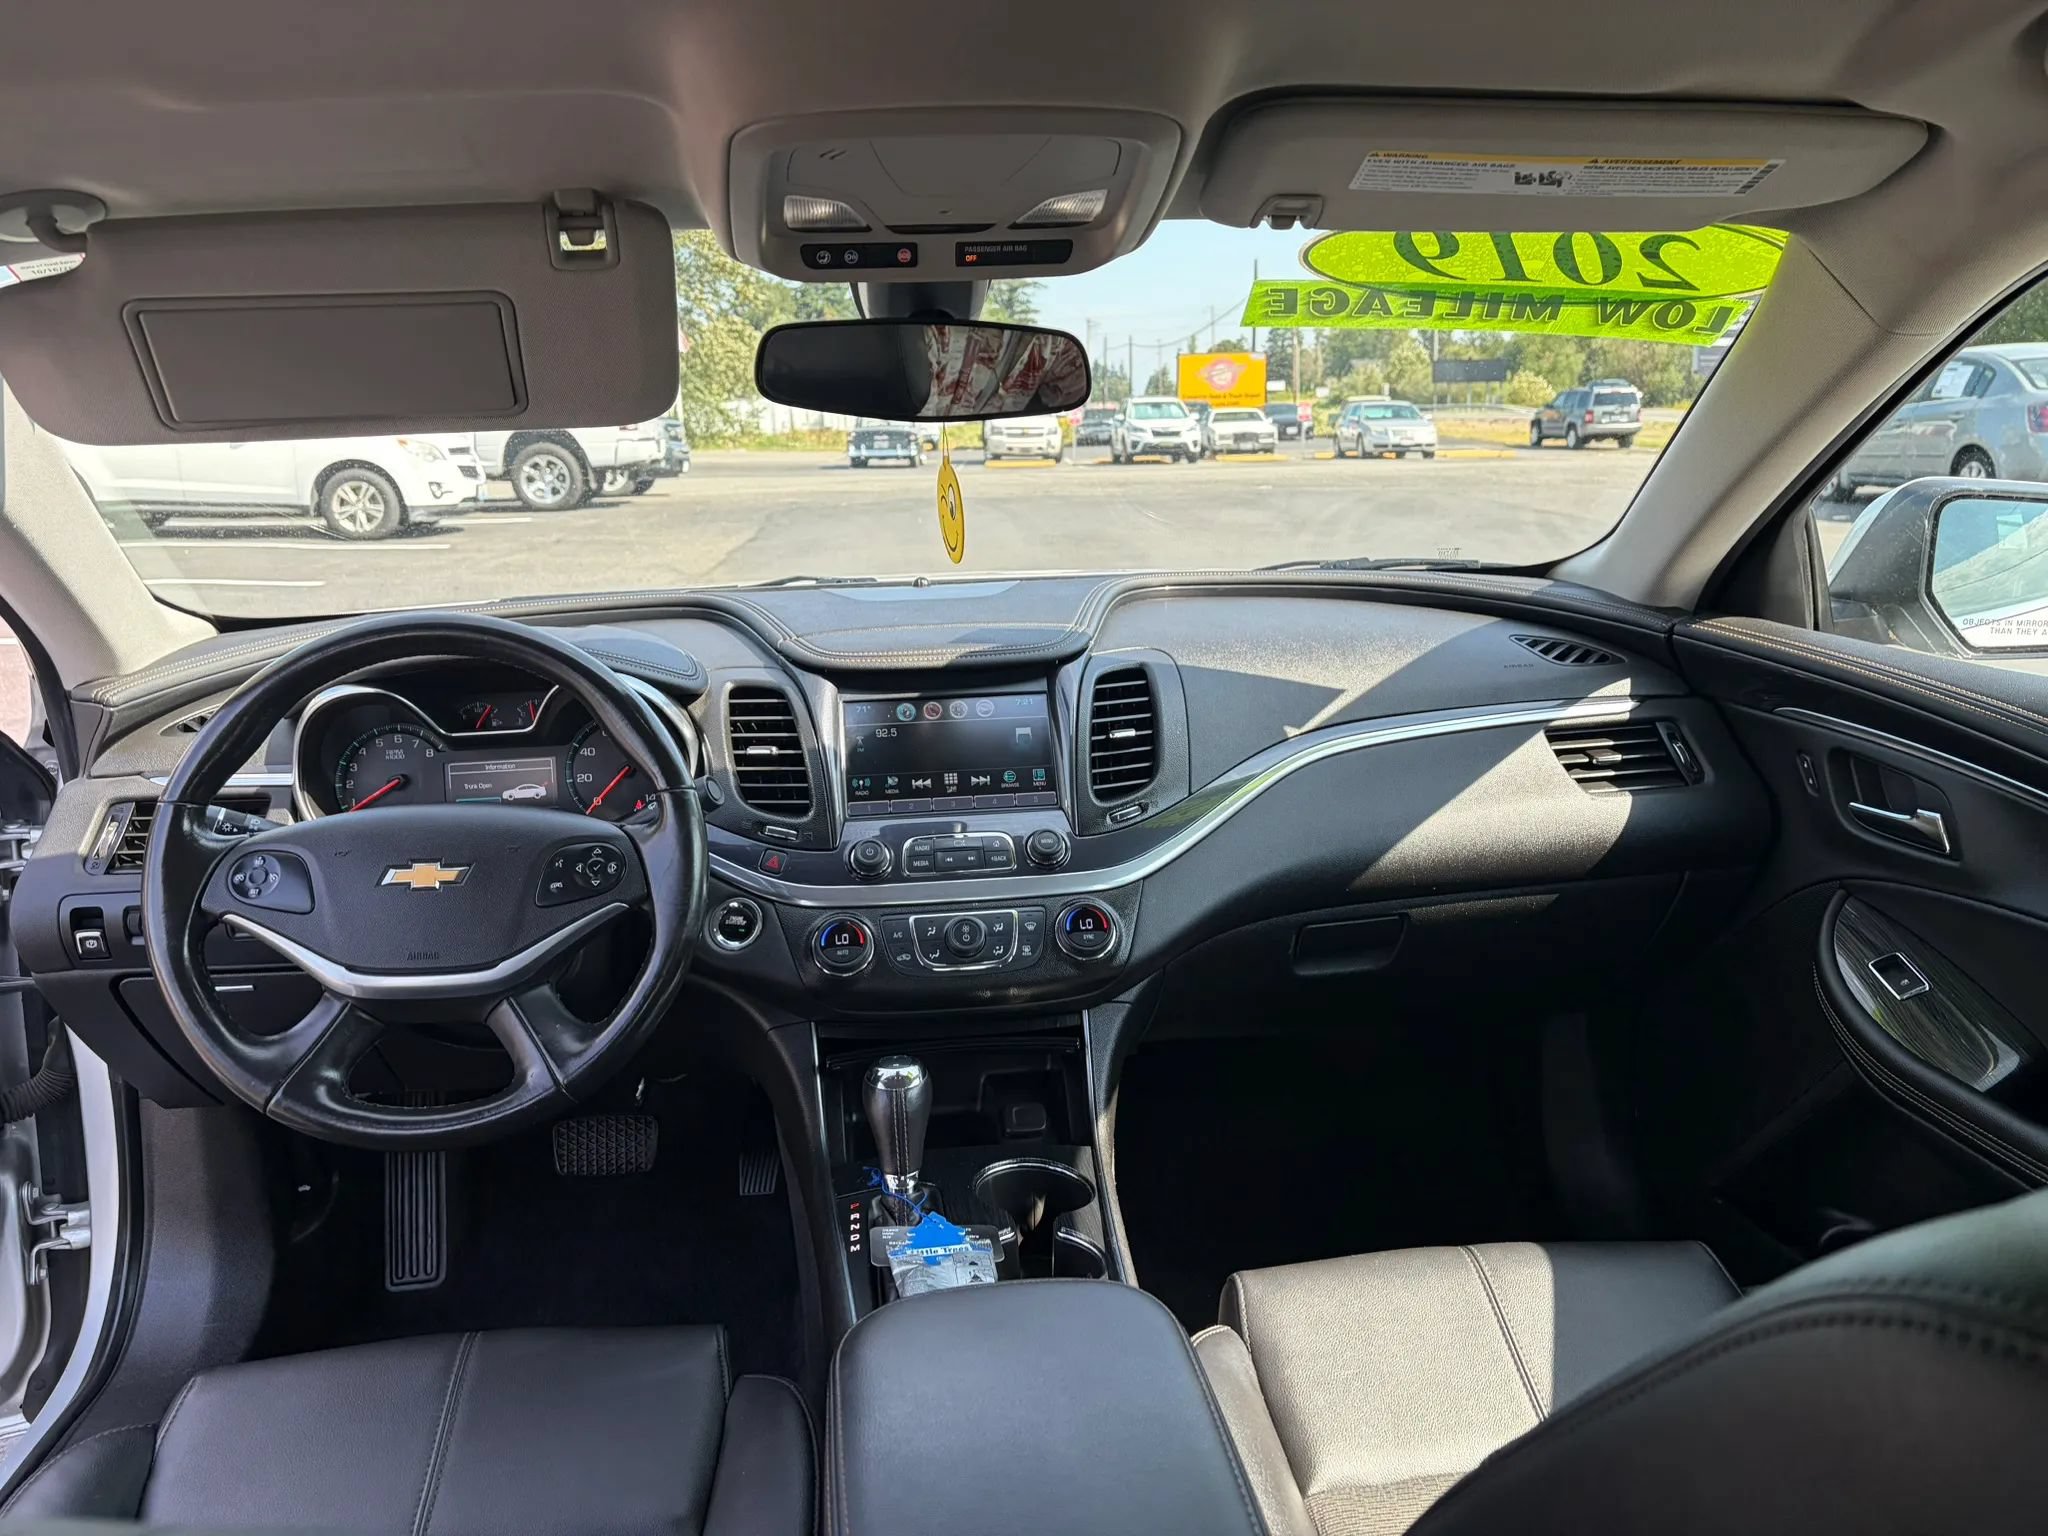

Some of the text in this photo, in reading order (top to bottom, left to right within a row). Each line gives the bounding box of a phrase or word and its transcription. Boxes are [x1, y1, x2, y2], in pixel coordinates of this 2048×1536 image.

[1962, 618, 2000, 626] OBJECTS
[875, 728, 898, 738] 92.5
[376, 739, 383, 747] 5
[394, 735, 402, 743] 6
[412, 739, 419, 748] 7
[358, 748, 366, 756] 4
[426, 749, 434, 757] 8
[580, 748, 596, 757] 40
[349, 763, 358, 772] 3
[577, 774, 592, 782] 20
[346, 780, 354, 788] 2
[1080, 918, 1093, 930] LO
[835, 933, 849, 945] LO
